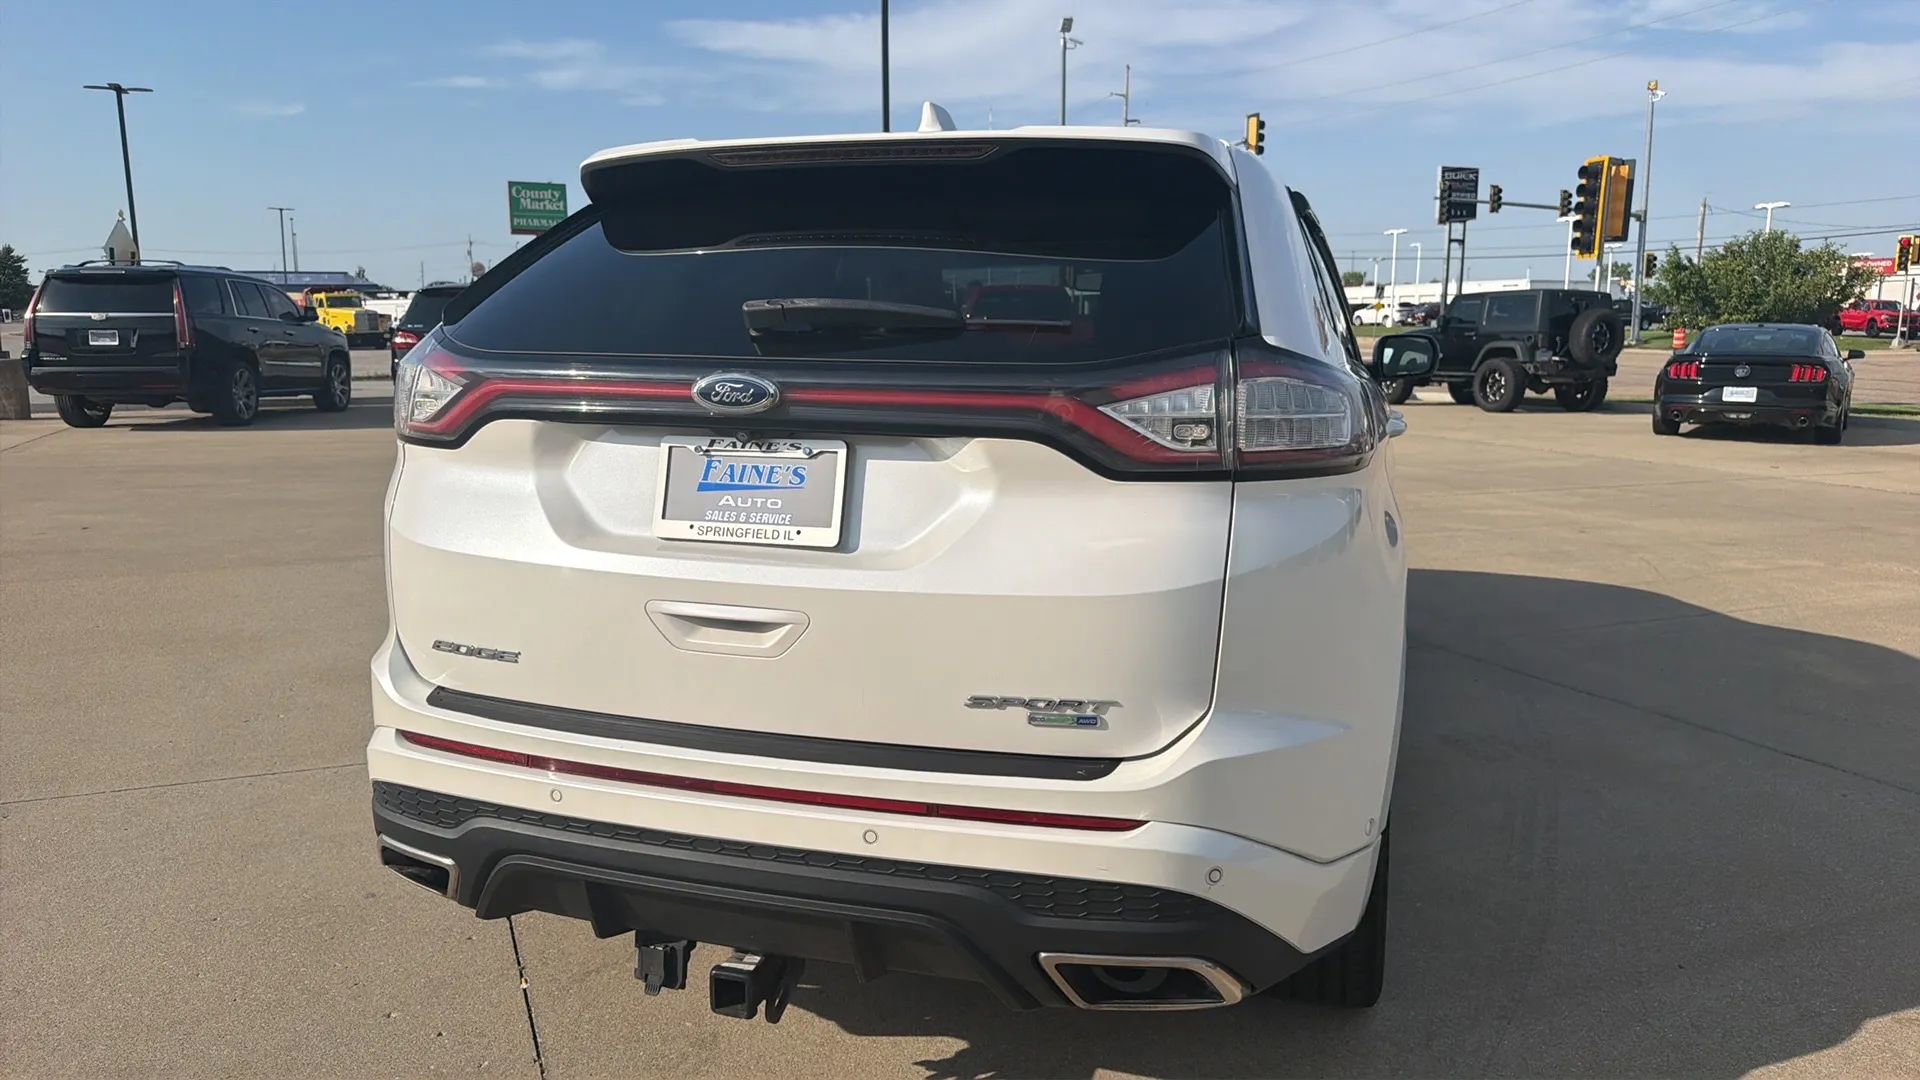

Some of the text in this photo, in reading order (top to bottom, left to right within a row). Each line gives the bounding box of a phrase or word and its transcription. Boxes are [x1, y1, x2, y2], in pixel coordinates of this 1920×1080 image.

[512, 186, 561, 201] County
[520, 198, 564, 210] Market
[710, 382, 754, 403] Ford
[707, 438, 802, 452] FAINE'S
[701, 458, 807, 487] FAINE'S
[718, 495, 782, 509] AUTO
[704, 510, 793, 525] SALES & SERVICE
[697, 525, 795, 541] SPRINGFIELD IL
[432, 640, 521, 664] EDGE
[964, 696, 1124, 715] SPORT
